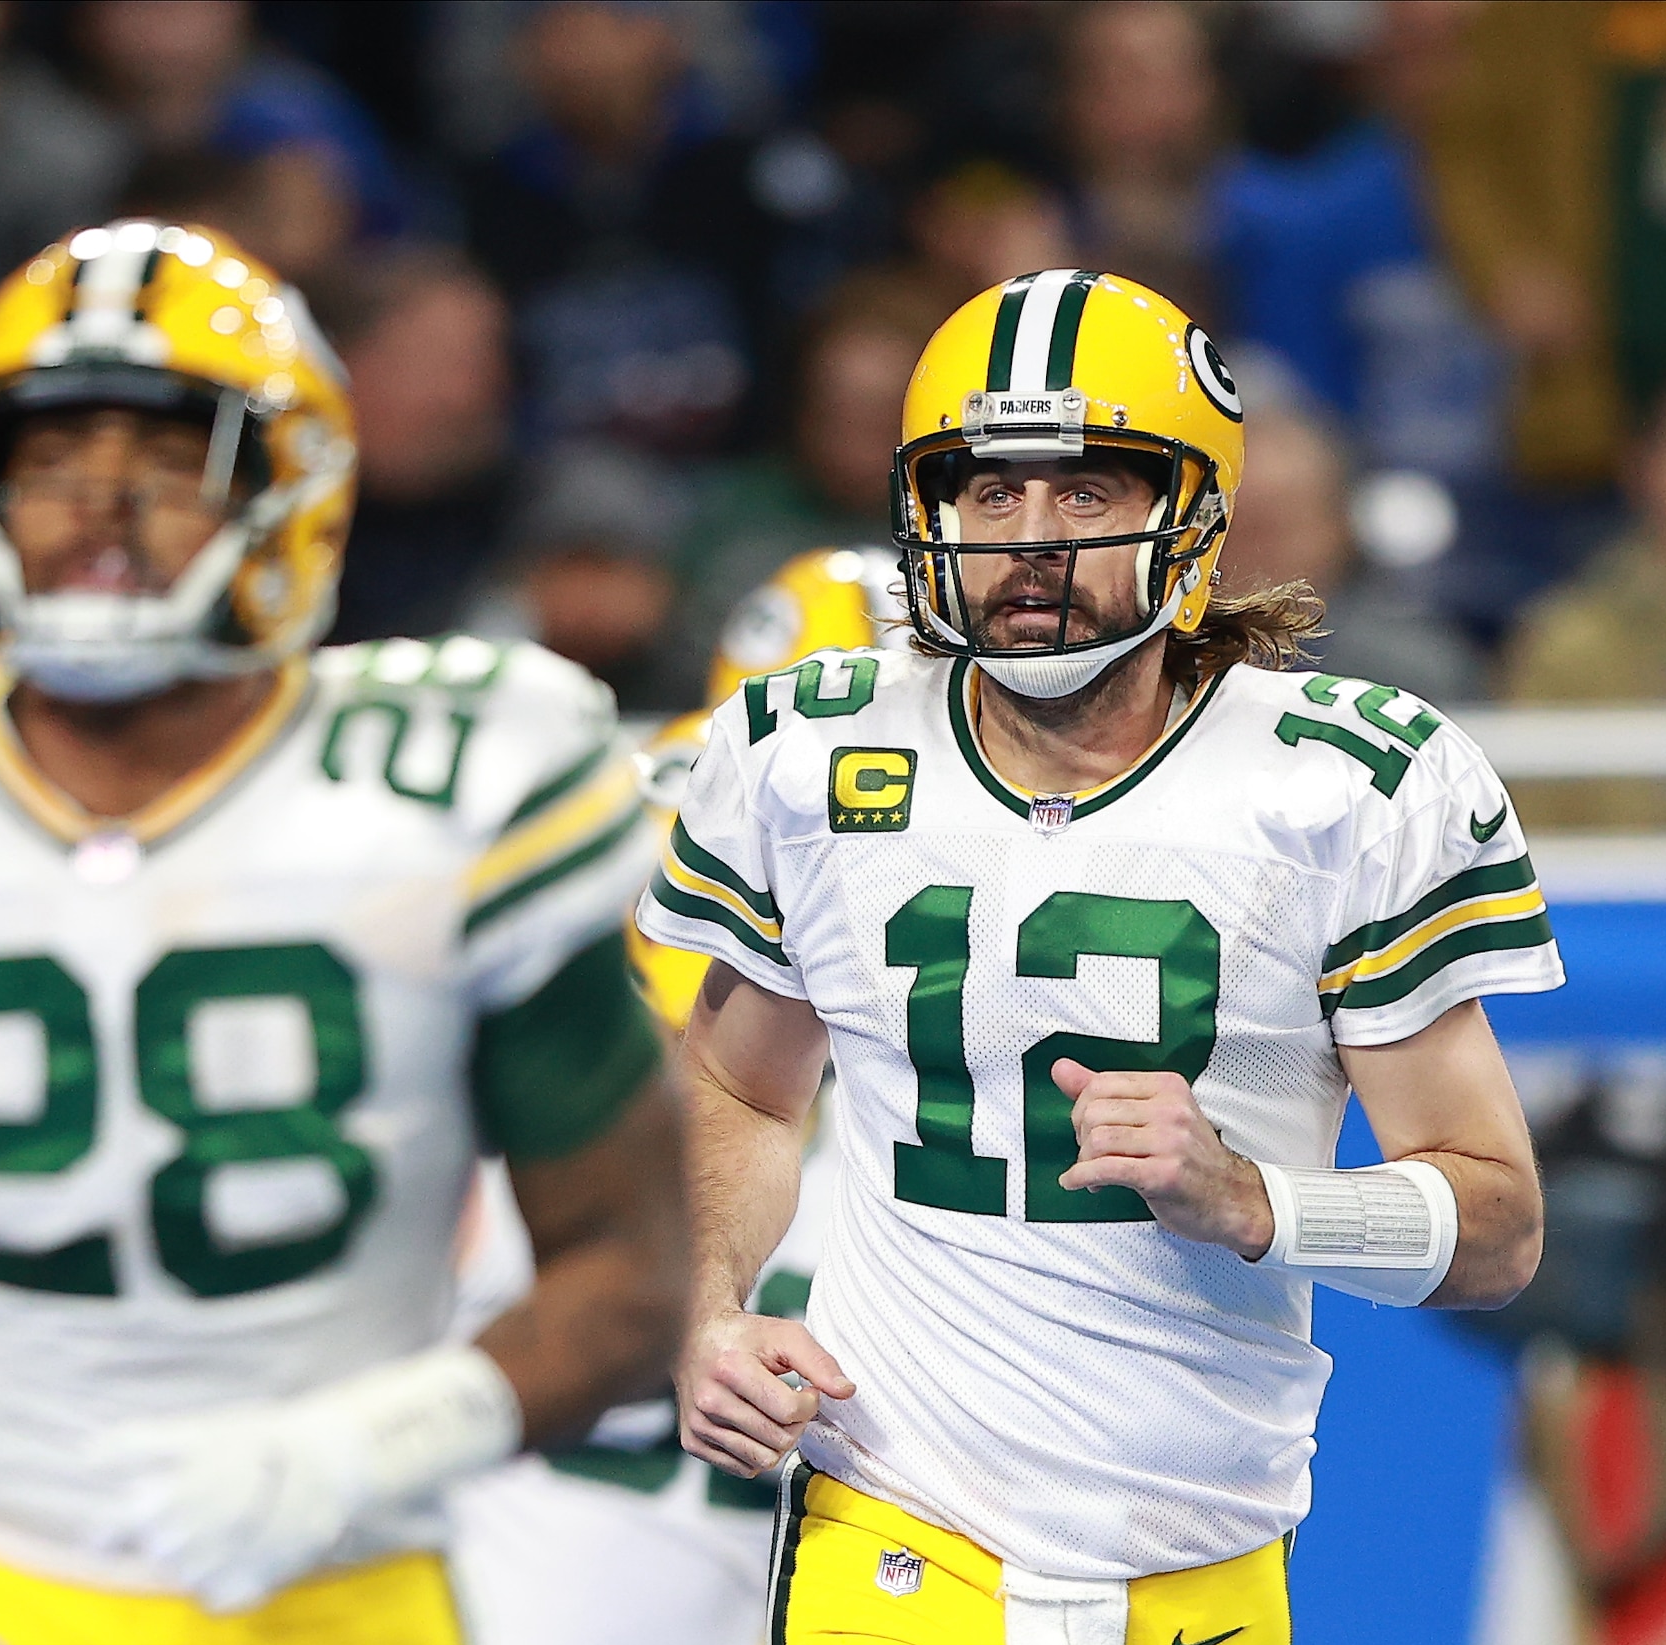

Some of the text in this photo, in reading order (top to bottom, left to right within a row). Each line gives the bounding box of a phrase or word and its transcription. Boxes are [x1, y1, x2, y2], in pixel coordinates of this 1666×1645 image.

[999, 400, 1052, 415] PACKERS
[744, 647, 880, 747] 2
[1274, 673, 1442, 800] 12
[834, 752, 910, 809] C
[1035, 809, 1065, 827] NFL
[884, 884, 1220, 1223] 12
[885, 1566, 914, 1586] NFL
